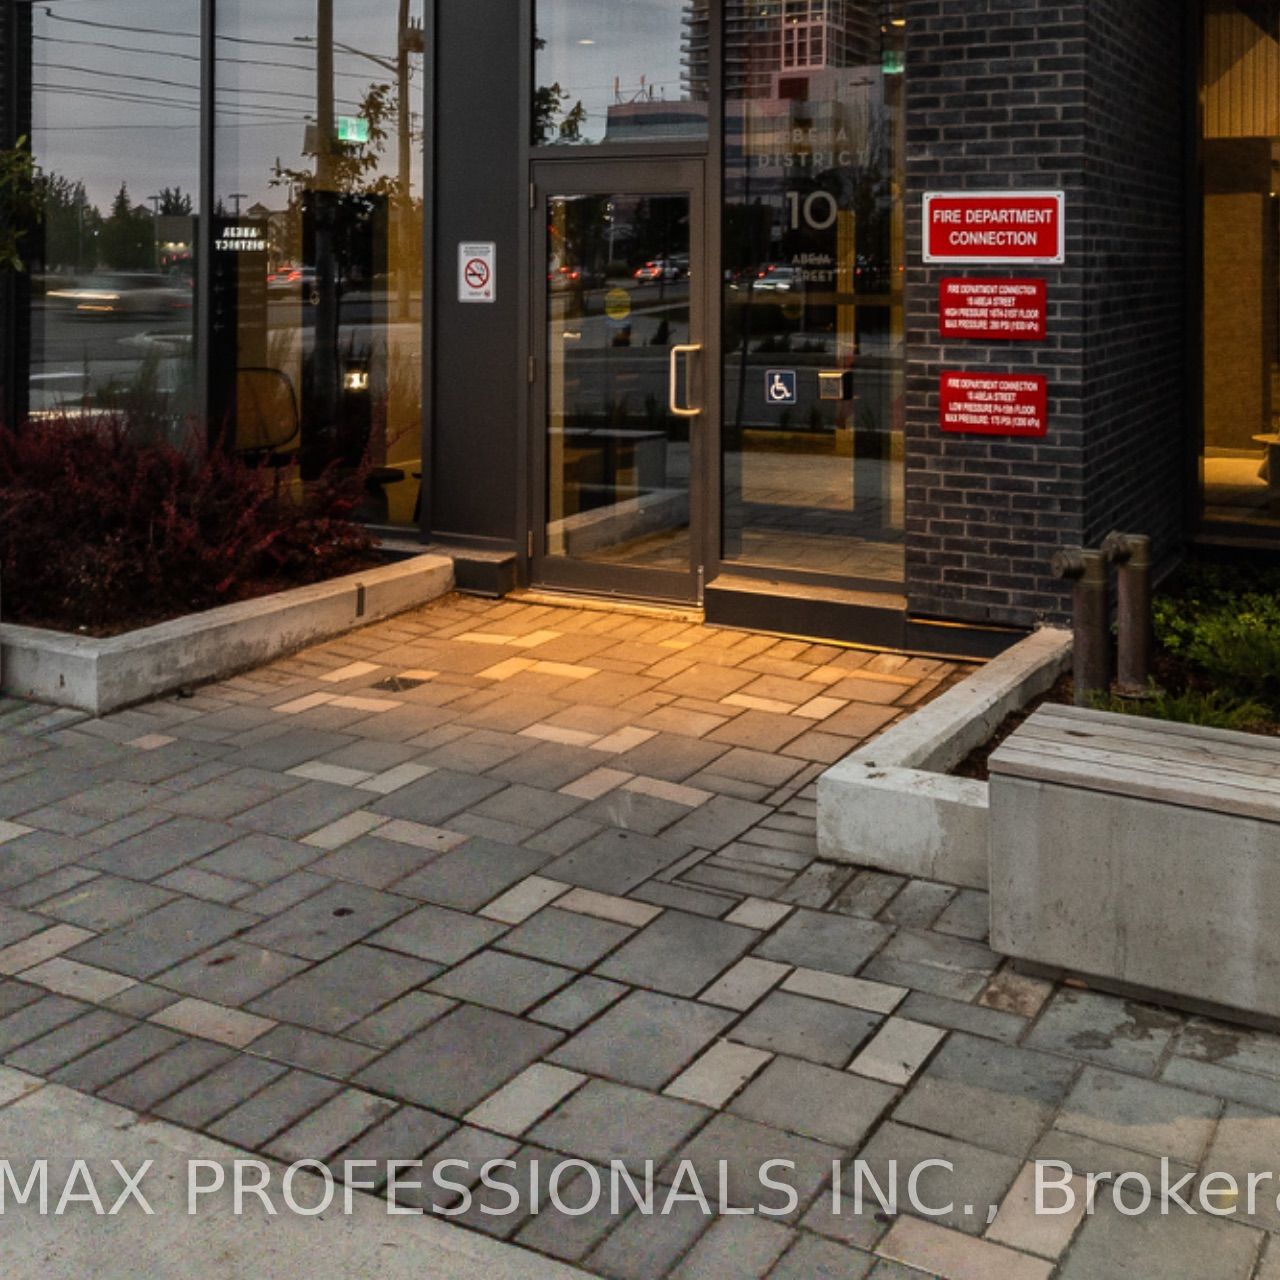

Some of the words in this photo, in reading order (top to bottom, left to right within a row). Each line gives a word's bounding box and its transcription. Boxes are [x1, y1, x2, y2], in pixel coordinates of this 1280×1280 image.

[758, 150, 867, 168] DISTRICT
[785, 190, 838, 230] 10
[933, 209, 961, 224] FIRE
[966, 208, 1053, 224] DEPARTMENT
[949, 231, 1038, 246] CONNECTION
[960, 284, 998, 294] DEPARTMENT
[998, 285, 1037, 295] CONNECTION
[960, 379, 998, 390] DEPARTMENT
[998, 380, 1039, 391] CONNECTION
